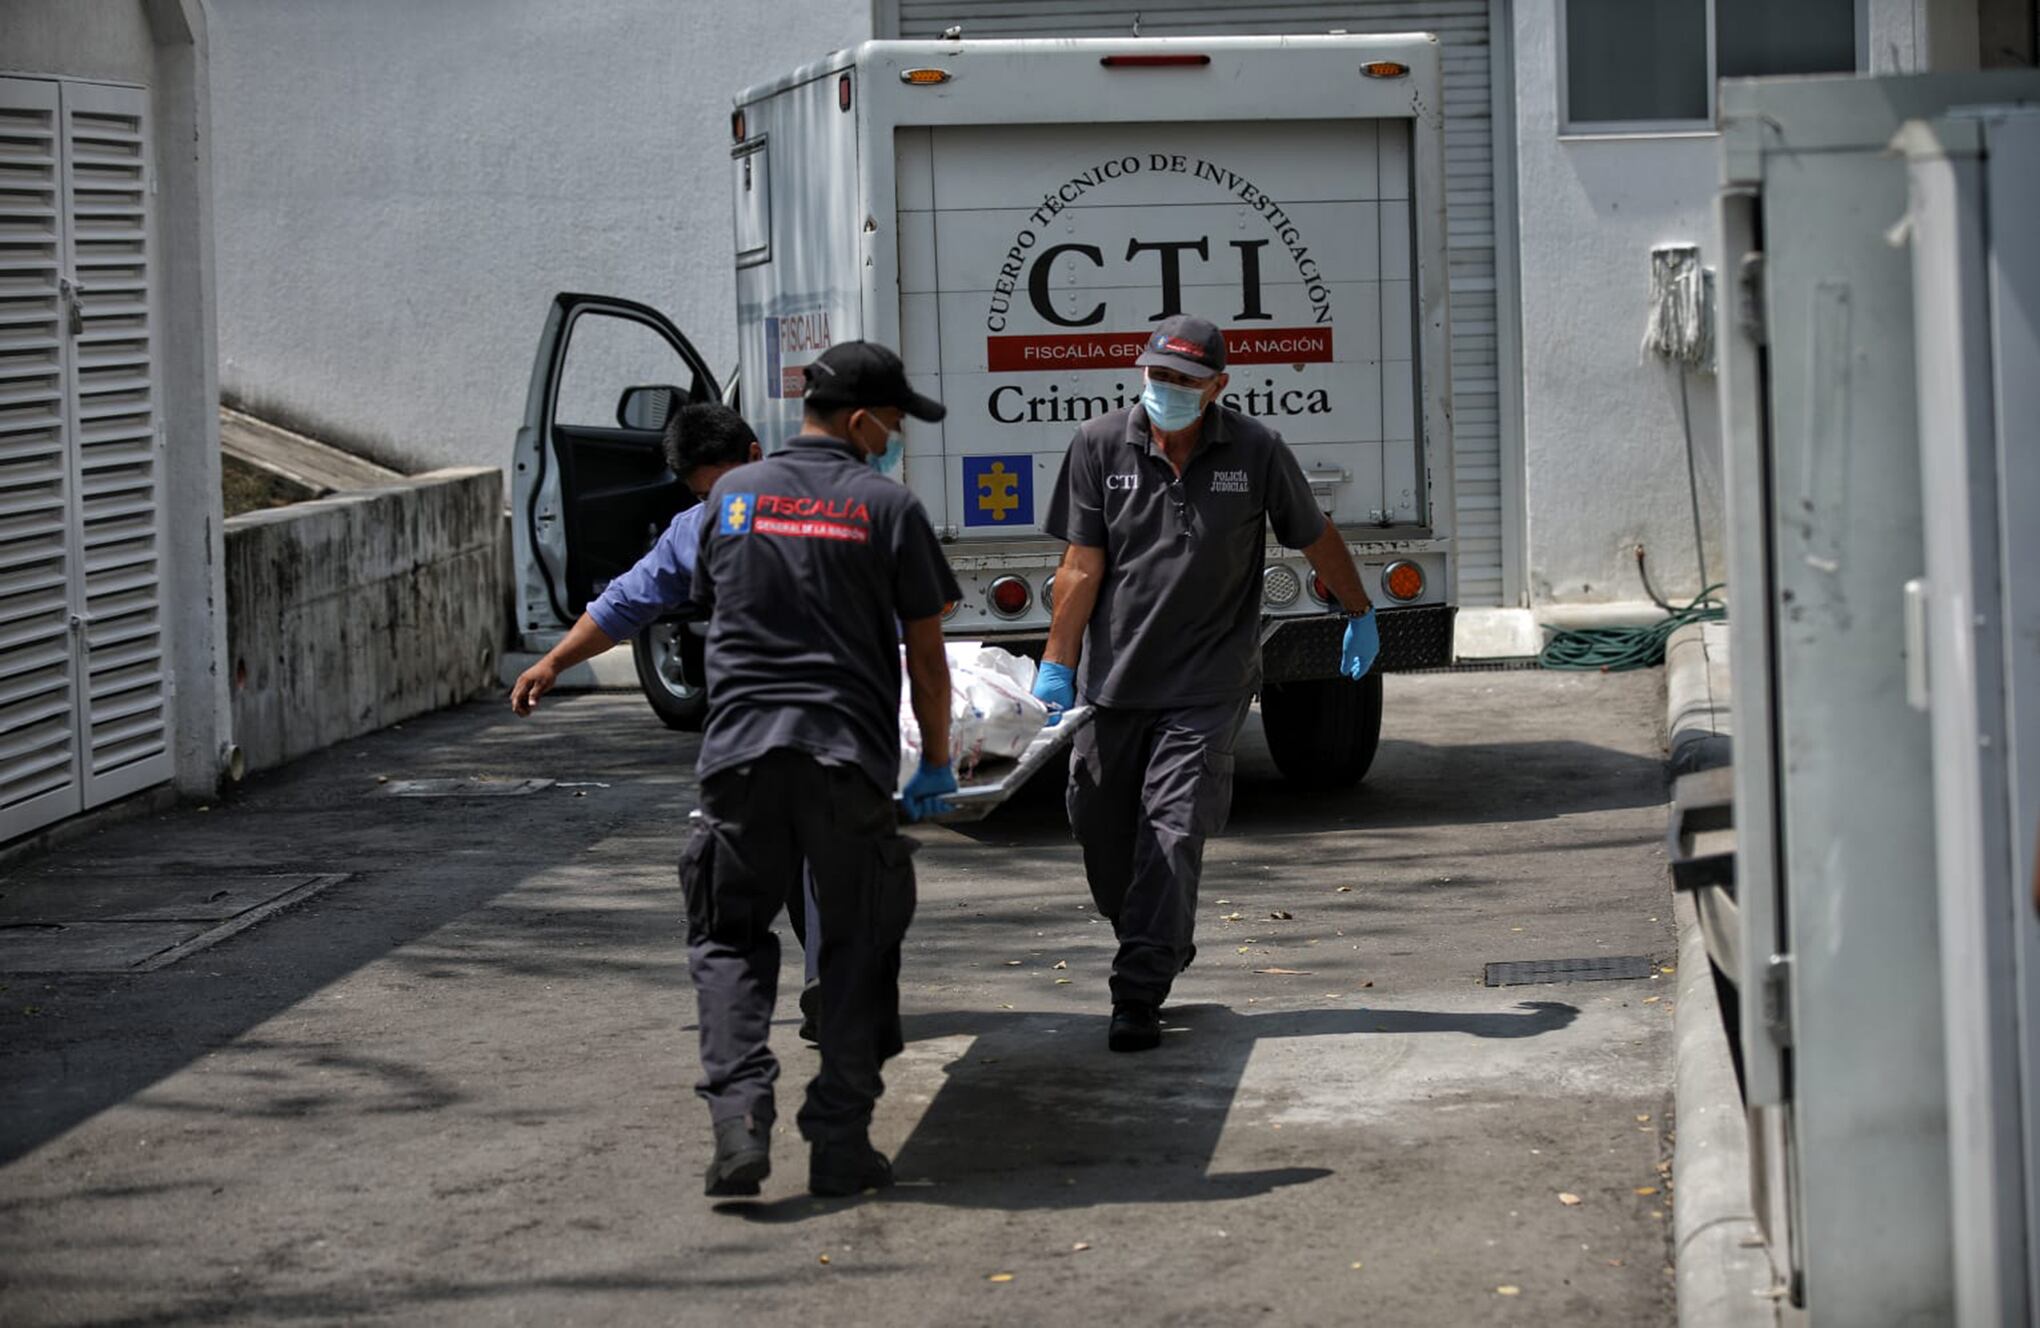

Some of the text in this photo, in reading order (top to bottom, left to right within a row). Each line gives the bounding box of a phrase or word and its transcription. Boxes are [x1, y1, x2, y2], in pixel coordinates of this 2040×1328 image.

[987, 154, 1333, 333] CUERPO TÉCNICO DE INVESTIGACIÓN
[1028, 236, 1273, 328] CTI
[1024, 343, 1105, 360] FISCALÍA
[1229, 340, 1251, 353] LA
[1255, 337, 1324, 353] NACIÓN
[988, 379, 1332, 423] Crimistica
[1105, 473, 1139, 490] CTI
[1210, 482, 1249, 492] JUDICIAL
[1213, 470, 1249, 482] POLICÍA
[756, 494, 869, 522] FISCALÍA
[814, 525, 826, 534] LA
